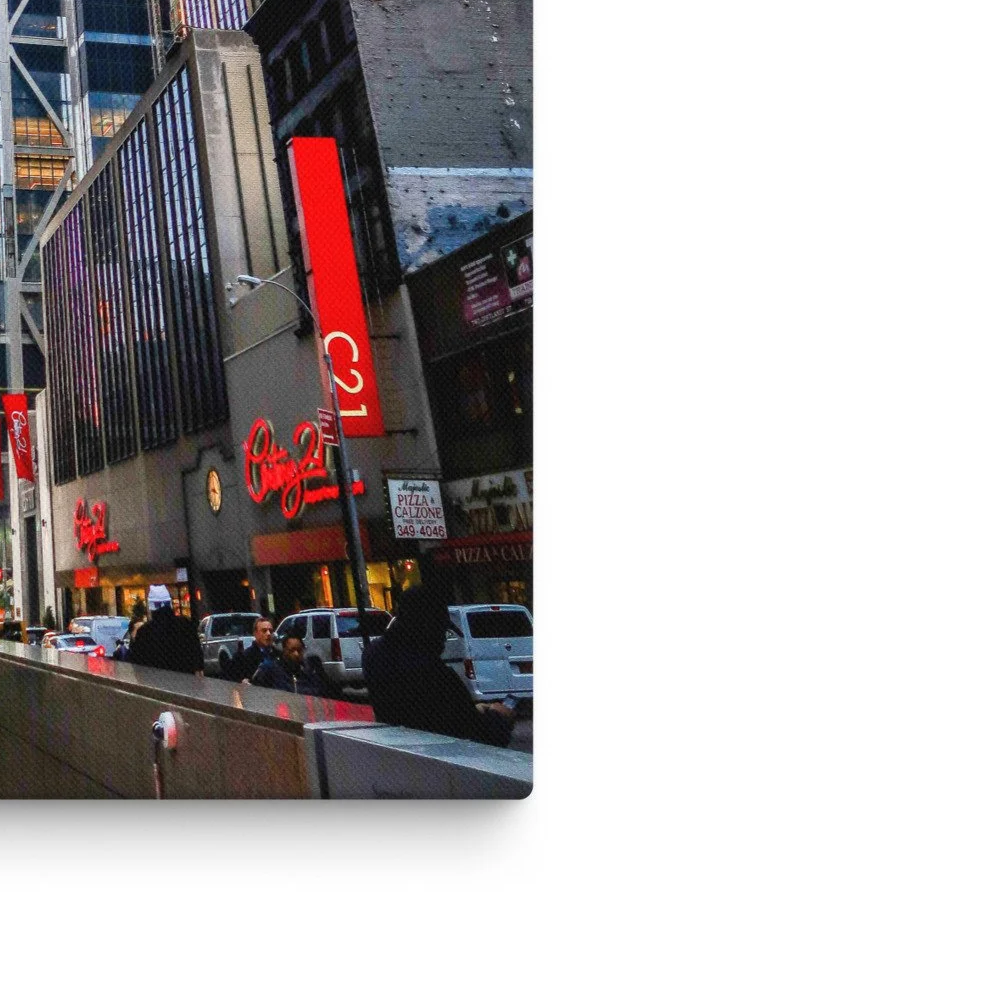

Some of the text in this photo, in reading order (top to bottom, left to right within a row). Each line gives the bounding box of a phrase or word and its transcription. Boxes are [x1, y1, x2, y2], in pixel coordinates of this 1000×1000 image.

[324, 331, 368, 418] C21
[397, 494, 429, 506] PIZZA
[394, 506, 443, 519] CALZONE
[455, 545, 492, 563] PIZZA
